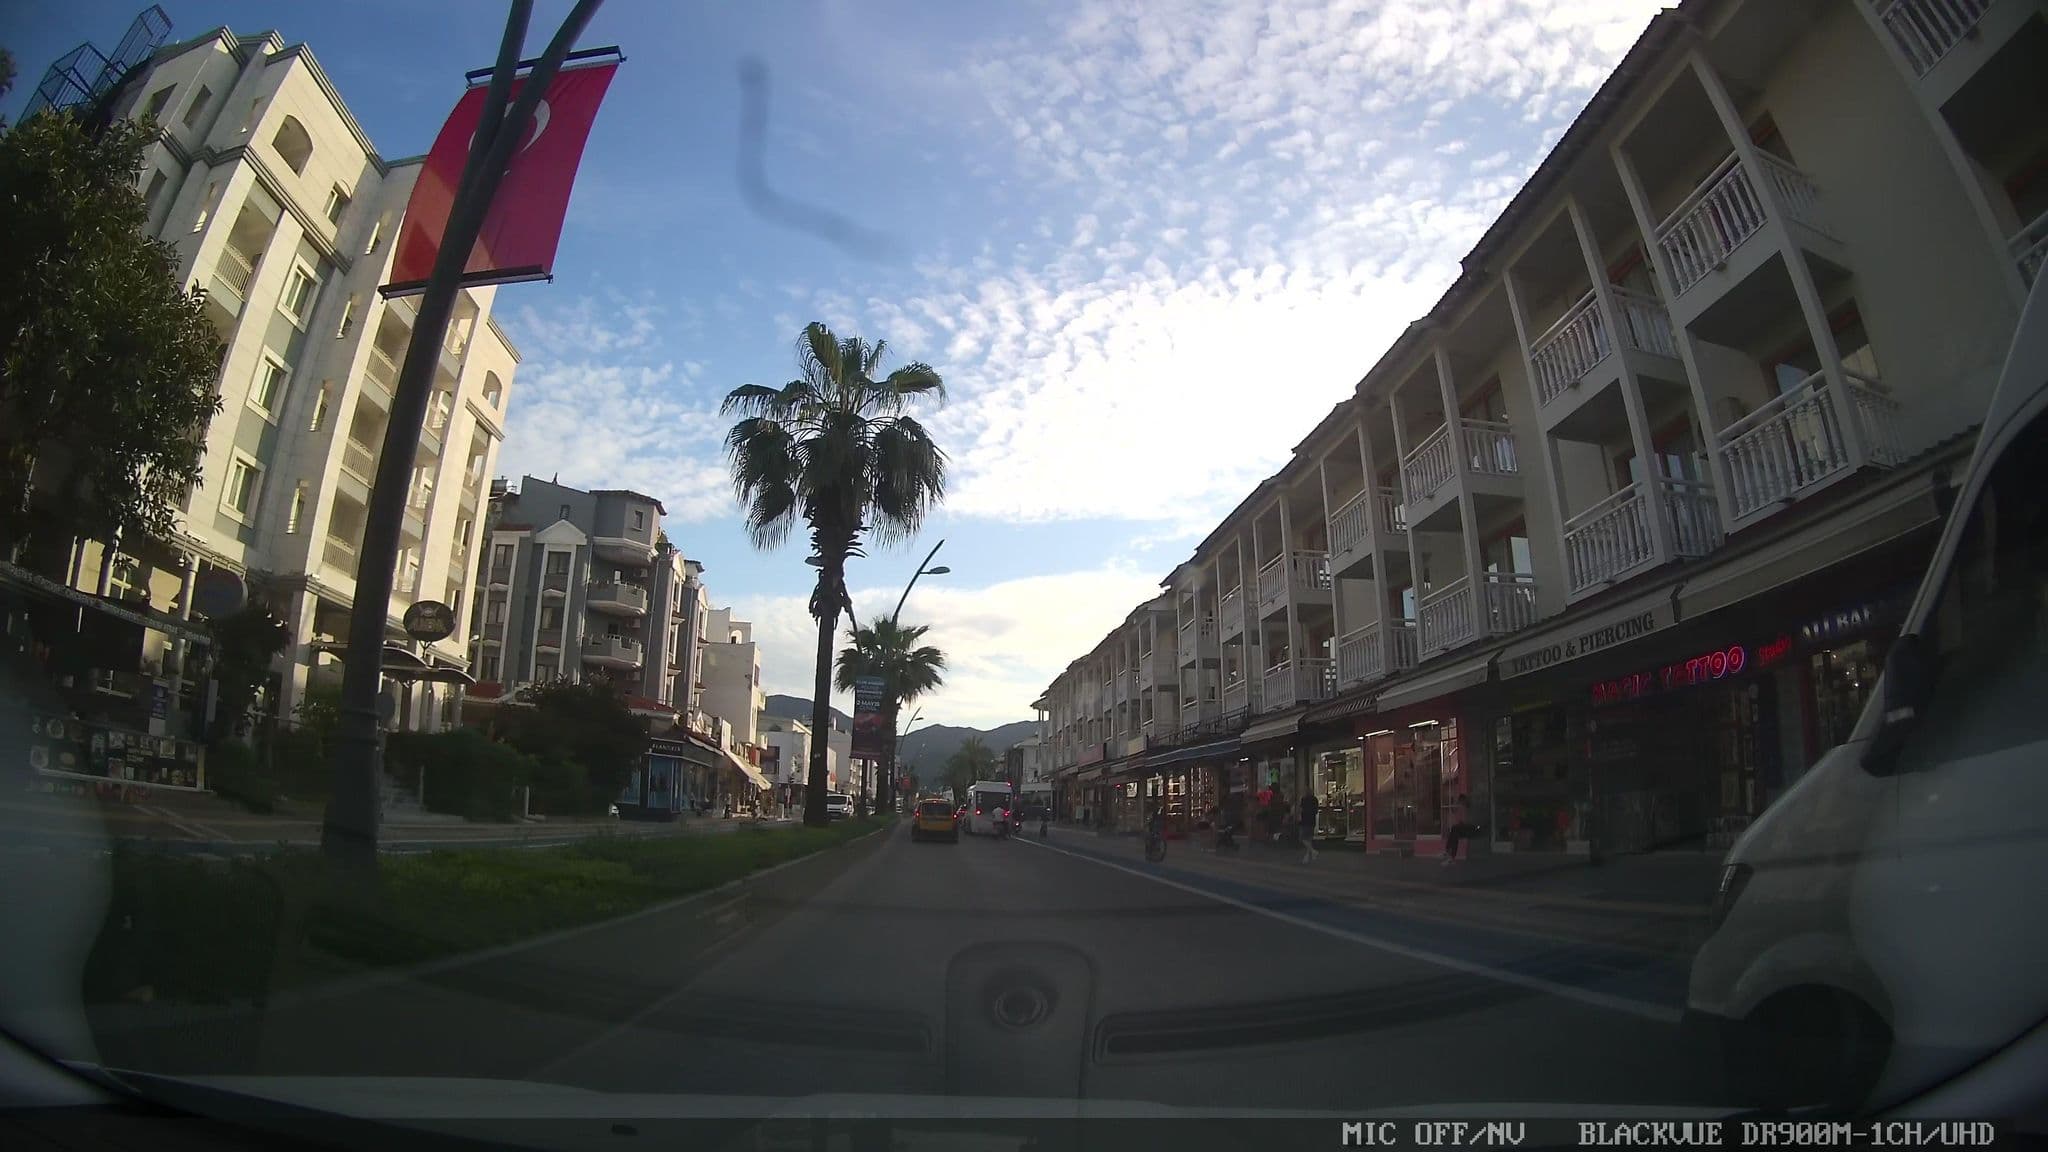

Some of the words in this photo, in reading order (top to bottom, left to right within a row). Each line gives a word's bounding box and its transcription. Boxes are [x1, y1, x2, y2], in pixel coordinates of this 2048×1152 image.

[1512, 646, 1561, 673] TATTOO
[1565, 641, 1576, 657] &
[1579, 612, 1653, 653] PIERCING
[1659, 643, 1745, 689] TATTOO
